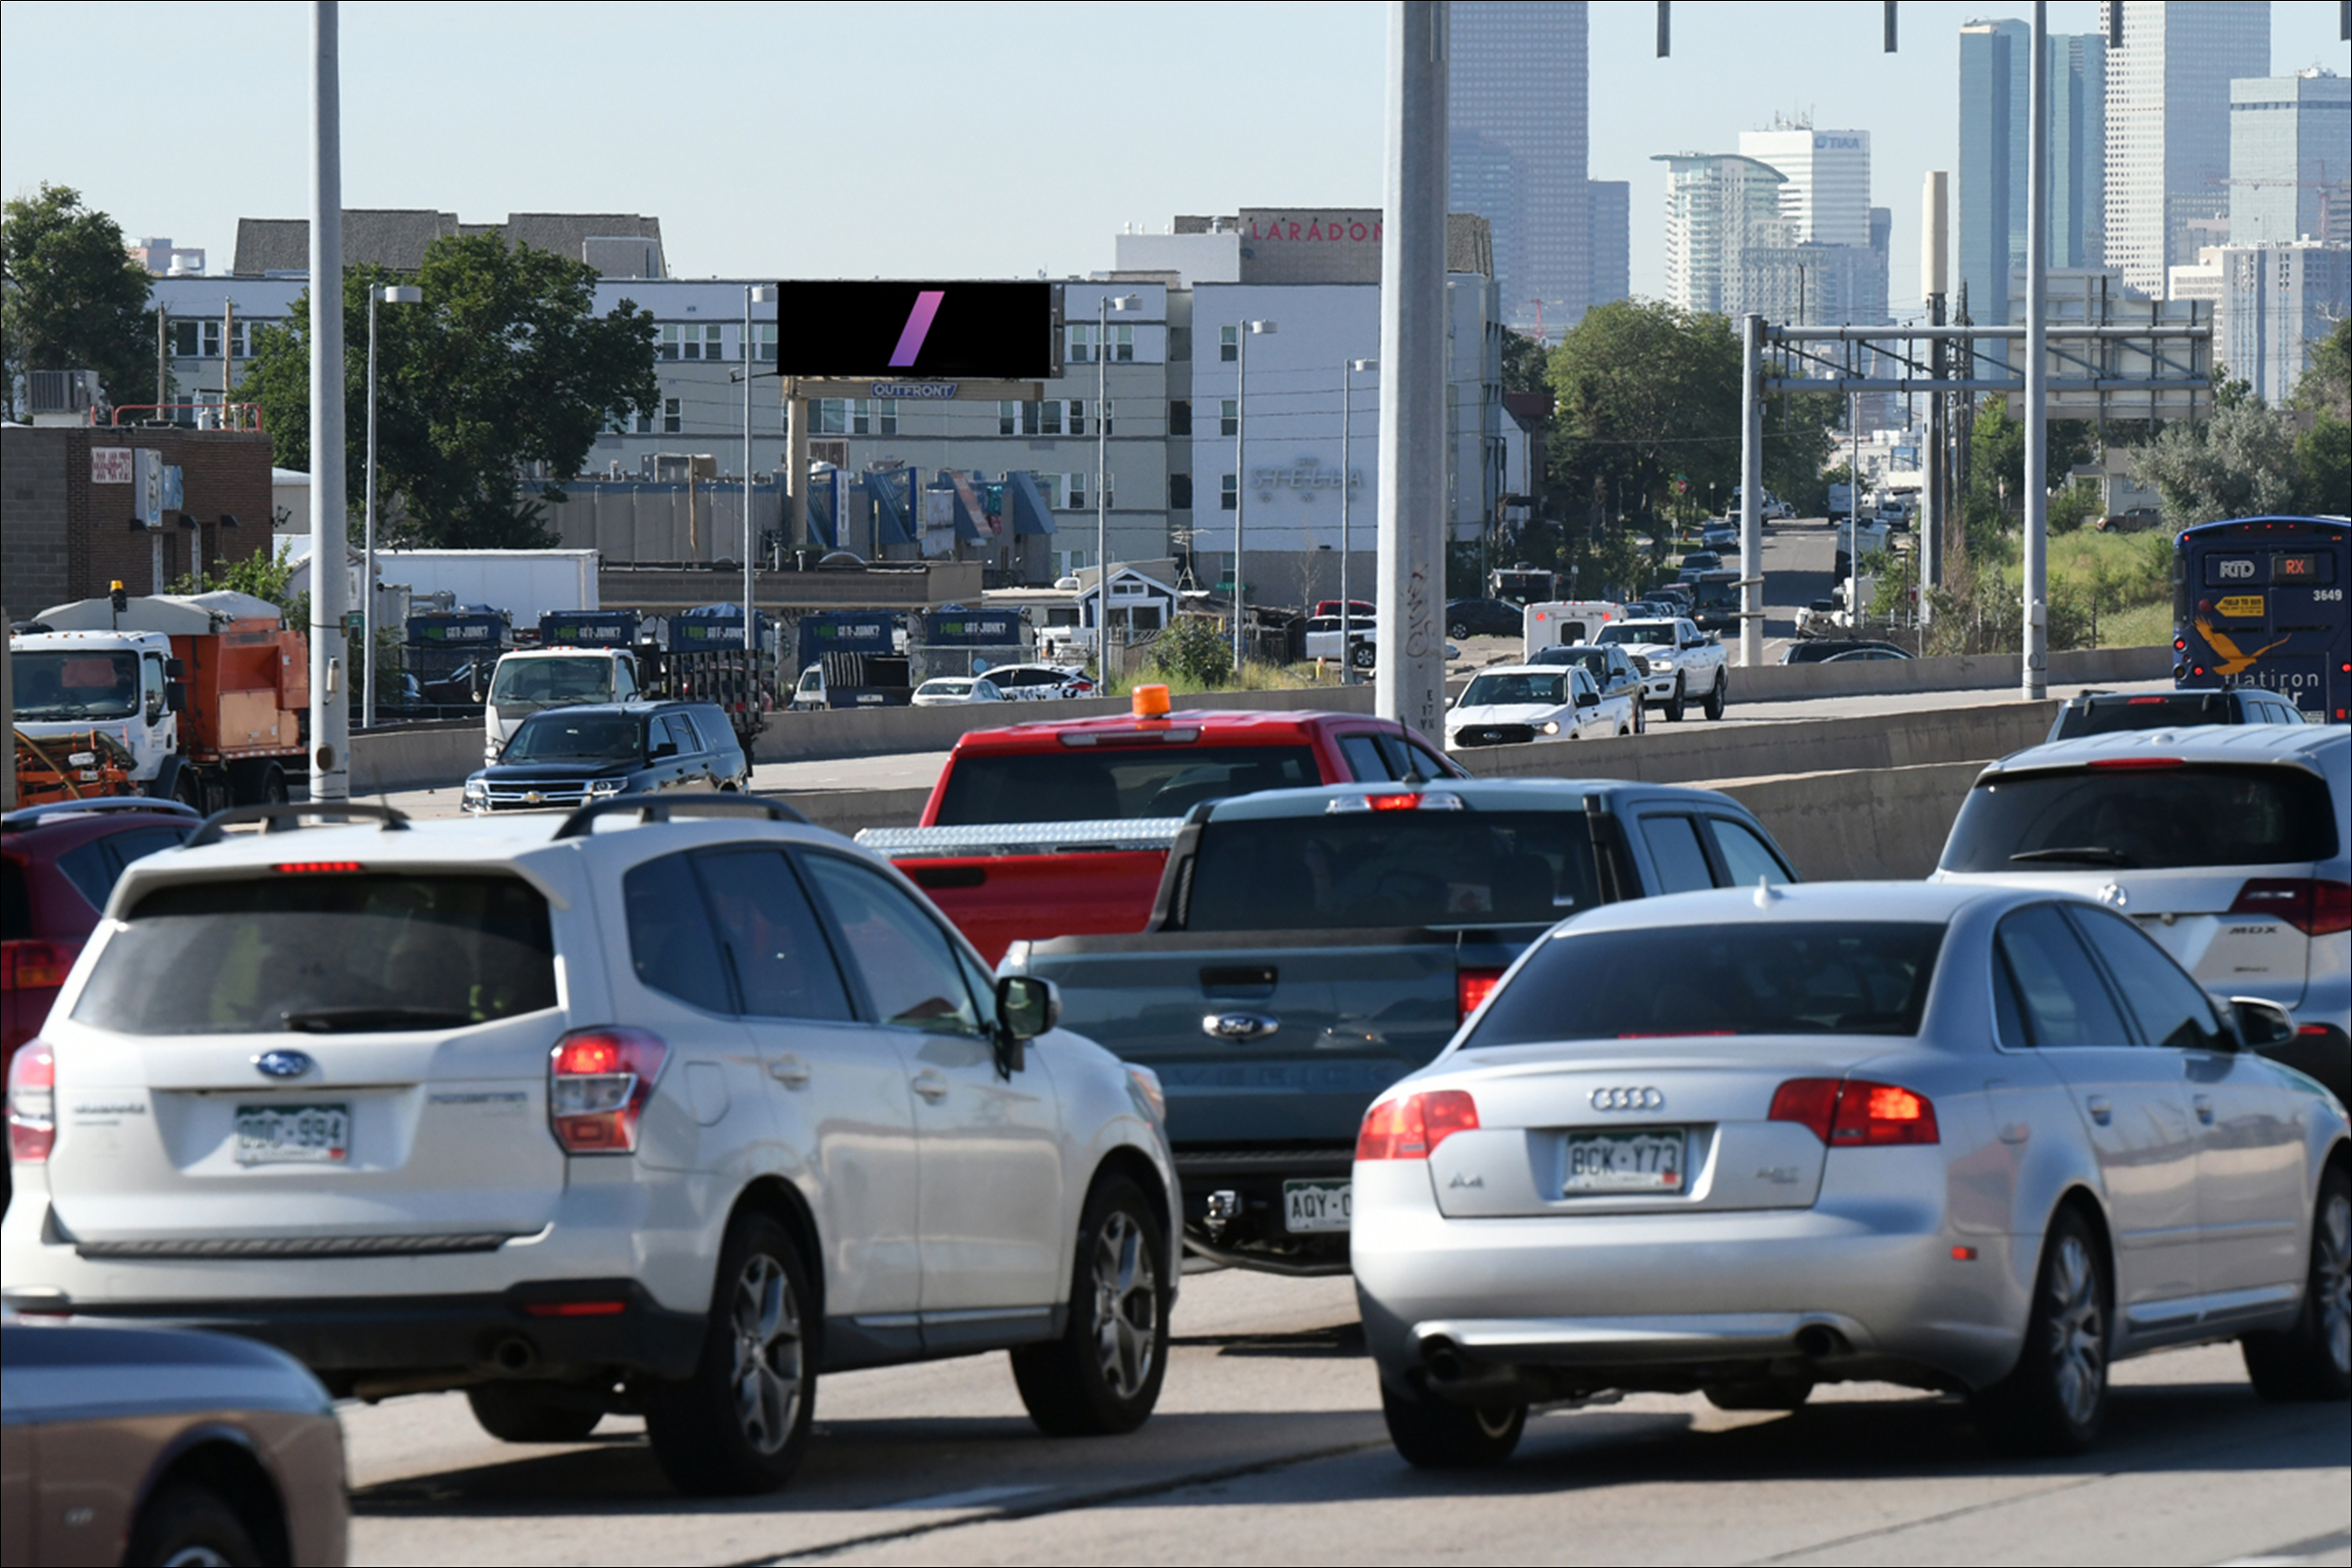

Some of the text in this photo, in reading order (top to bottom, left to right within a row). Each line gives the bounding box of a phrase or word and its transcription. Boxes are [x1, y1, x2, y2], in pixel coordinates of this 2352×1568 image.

[1829, 137, 1860, 149] TIAA
[874, 384, 951, 397] OUTFRONT
[1253, 468, 1362, 489] STELLA
[2220, 561, 2255, 578] RTD
[2285, 560, 2305, 574] RX
[2313, 589, 2342, 601] 3649
[2225, 669, 2319, 687] flatiron
[2230, 926, 2277, 935] MDX
